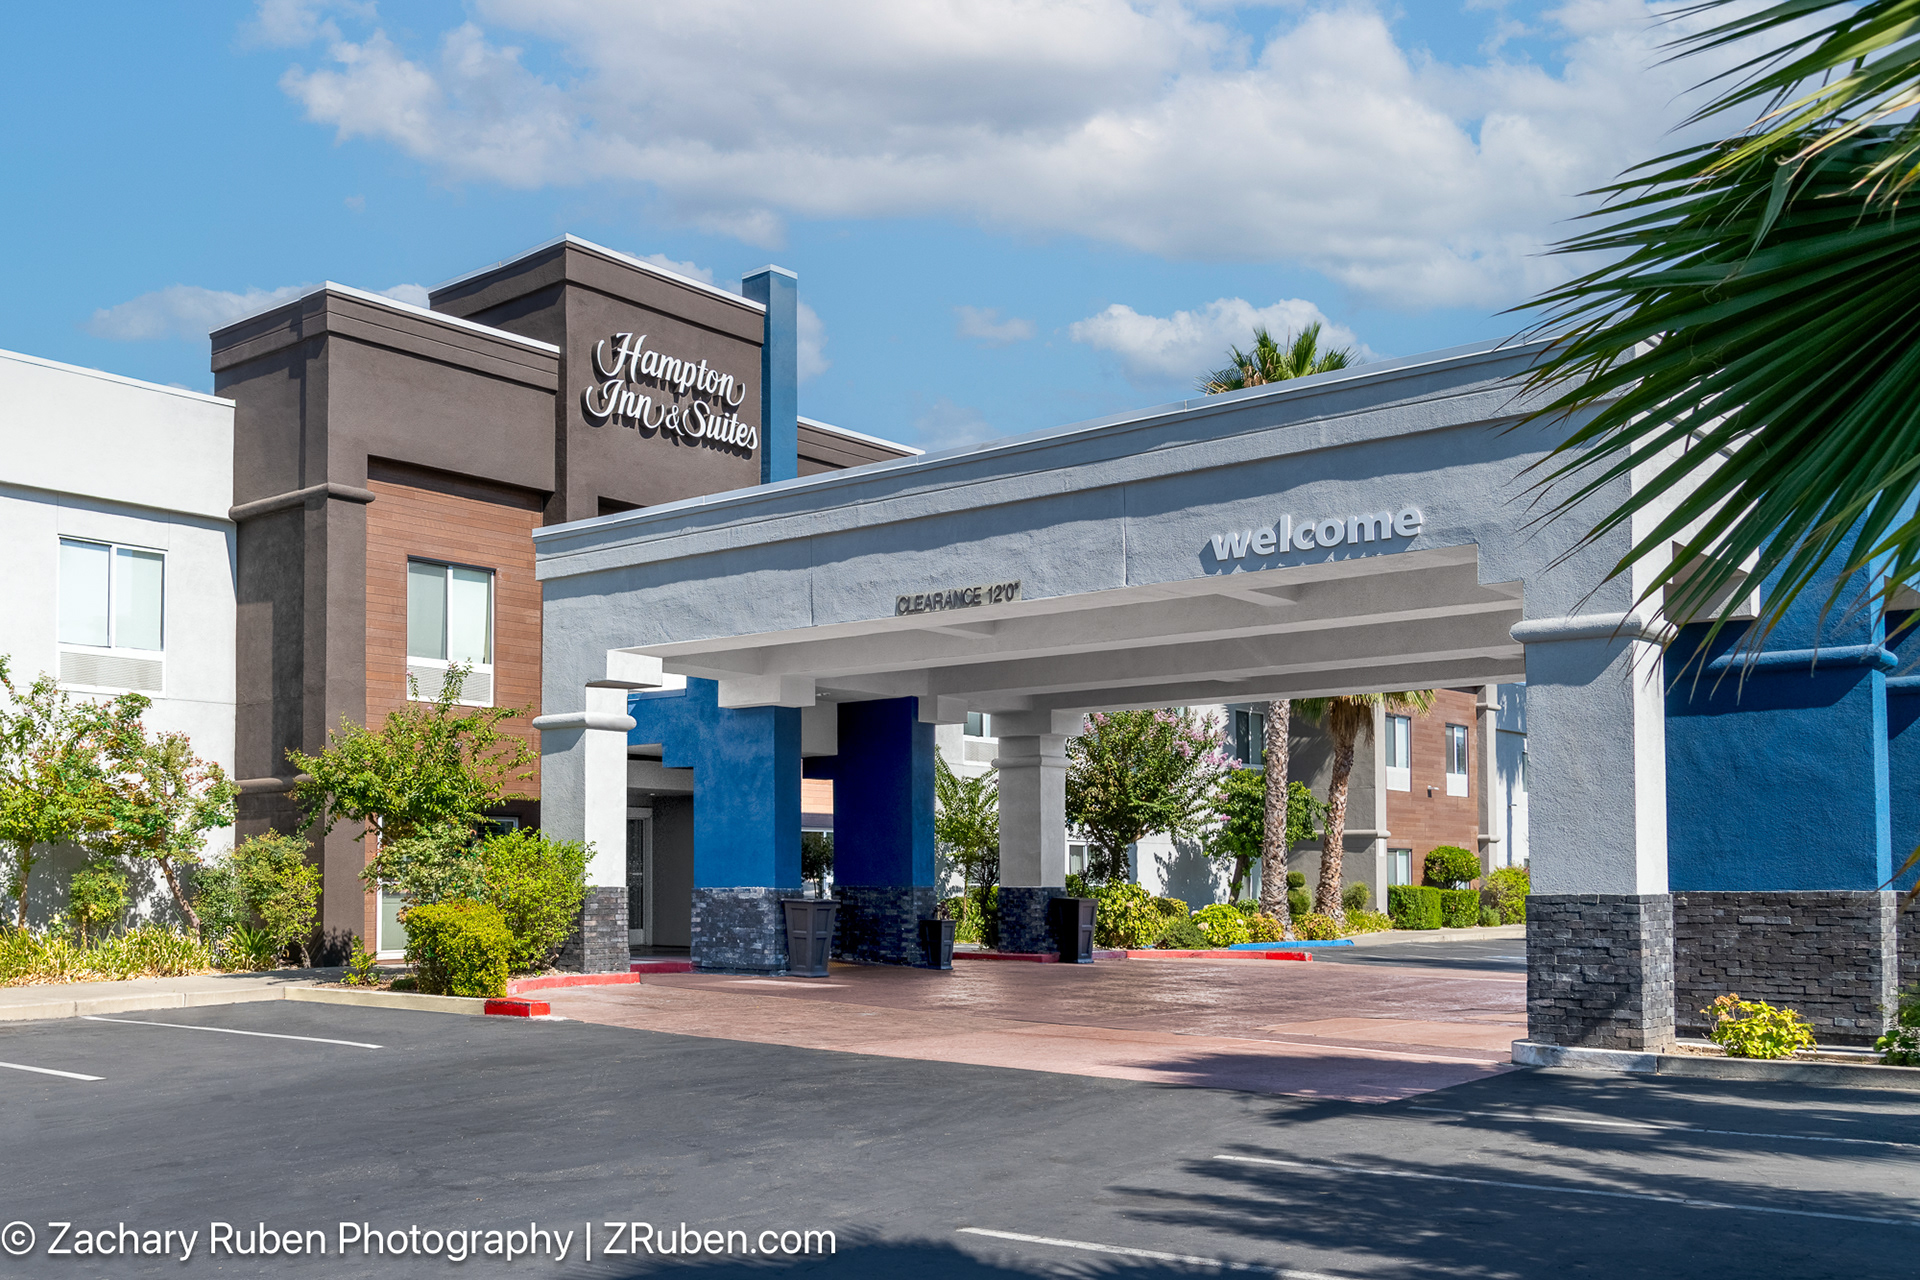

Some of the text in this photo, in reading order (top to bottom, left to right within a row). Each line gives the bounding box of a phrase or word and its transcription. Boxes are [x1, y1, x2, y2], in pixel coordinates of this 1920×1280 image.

[597, 332, 746, 406] Hampton
[586, 379, 759, 450] Inn & Suites
[1210, 507, 1423, 561] welcome
[897, 586, 982, 614] CLEARANCE
